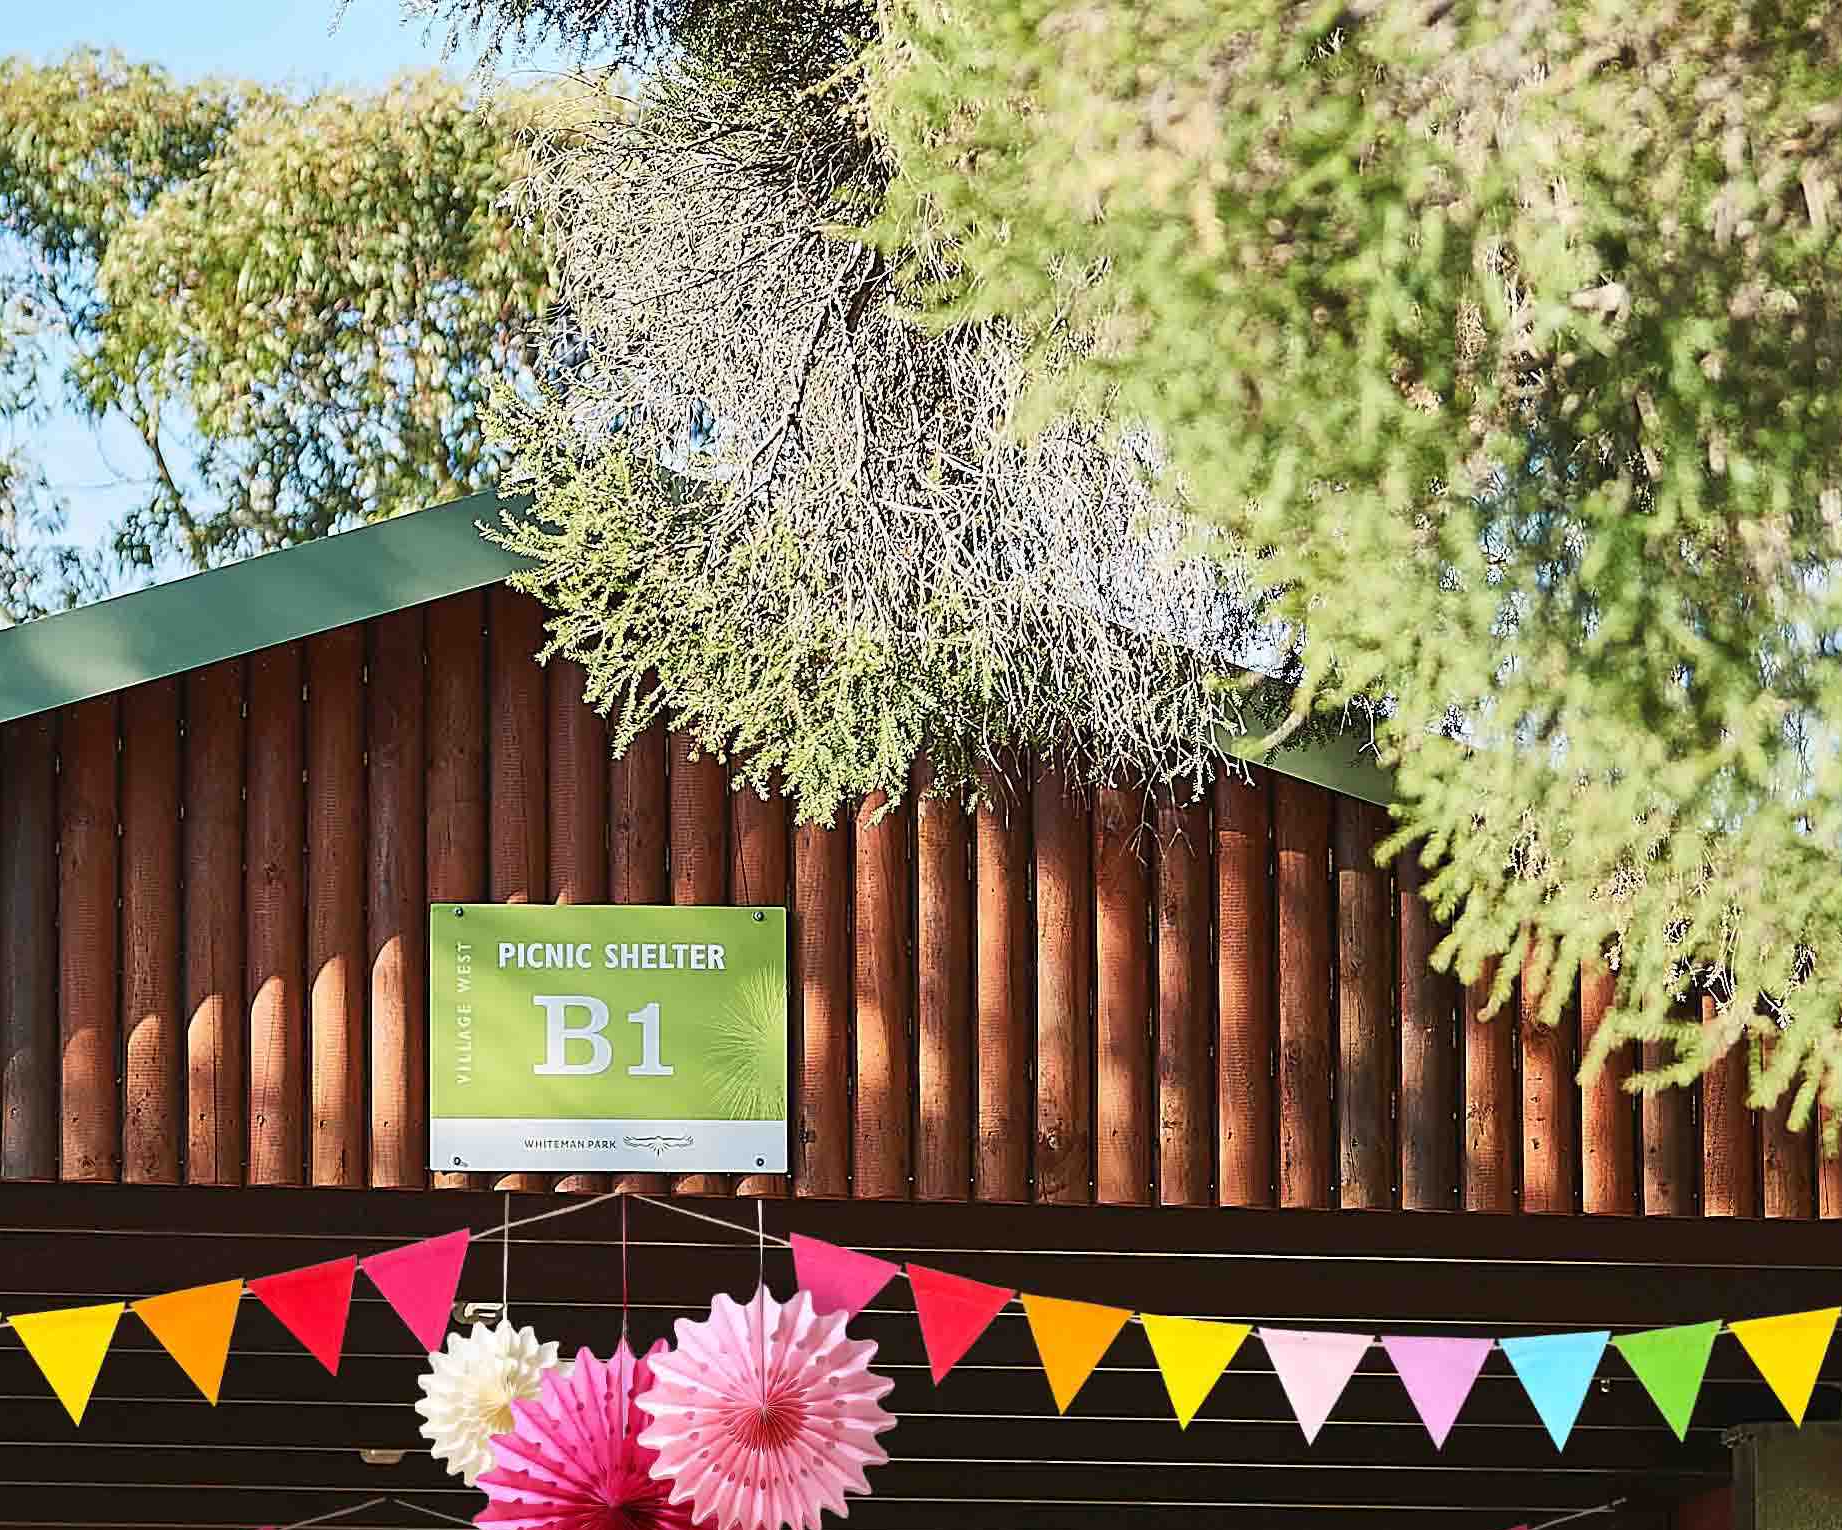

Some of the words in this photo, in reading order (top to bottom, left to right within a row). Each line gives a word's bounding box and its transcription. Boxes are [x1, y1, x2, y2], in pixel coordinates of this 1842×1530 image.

[455, 942, 472, 994] WEST
[497, 942, 592, 970] PICNIC
[604, 942, 727, 970] SHELTER
[455, 997, 472, 1086] VILLAGE
[532, 994, 674, 1077] B1
[523, 1138, 586, 1151] WHITEMAN
[587, 1138, 617, 1151] PARK
